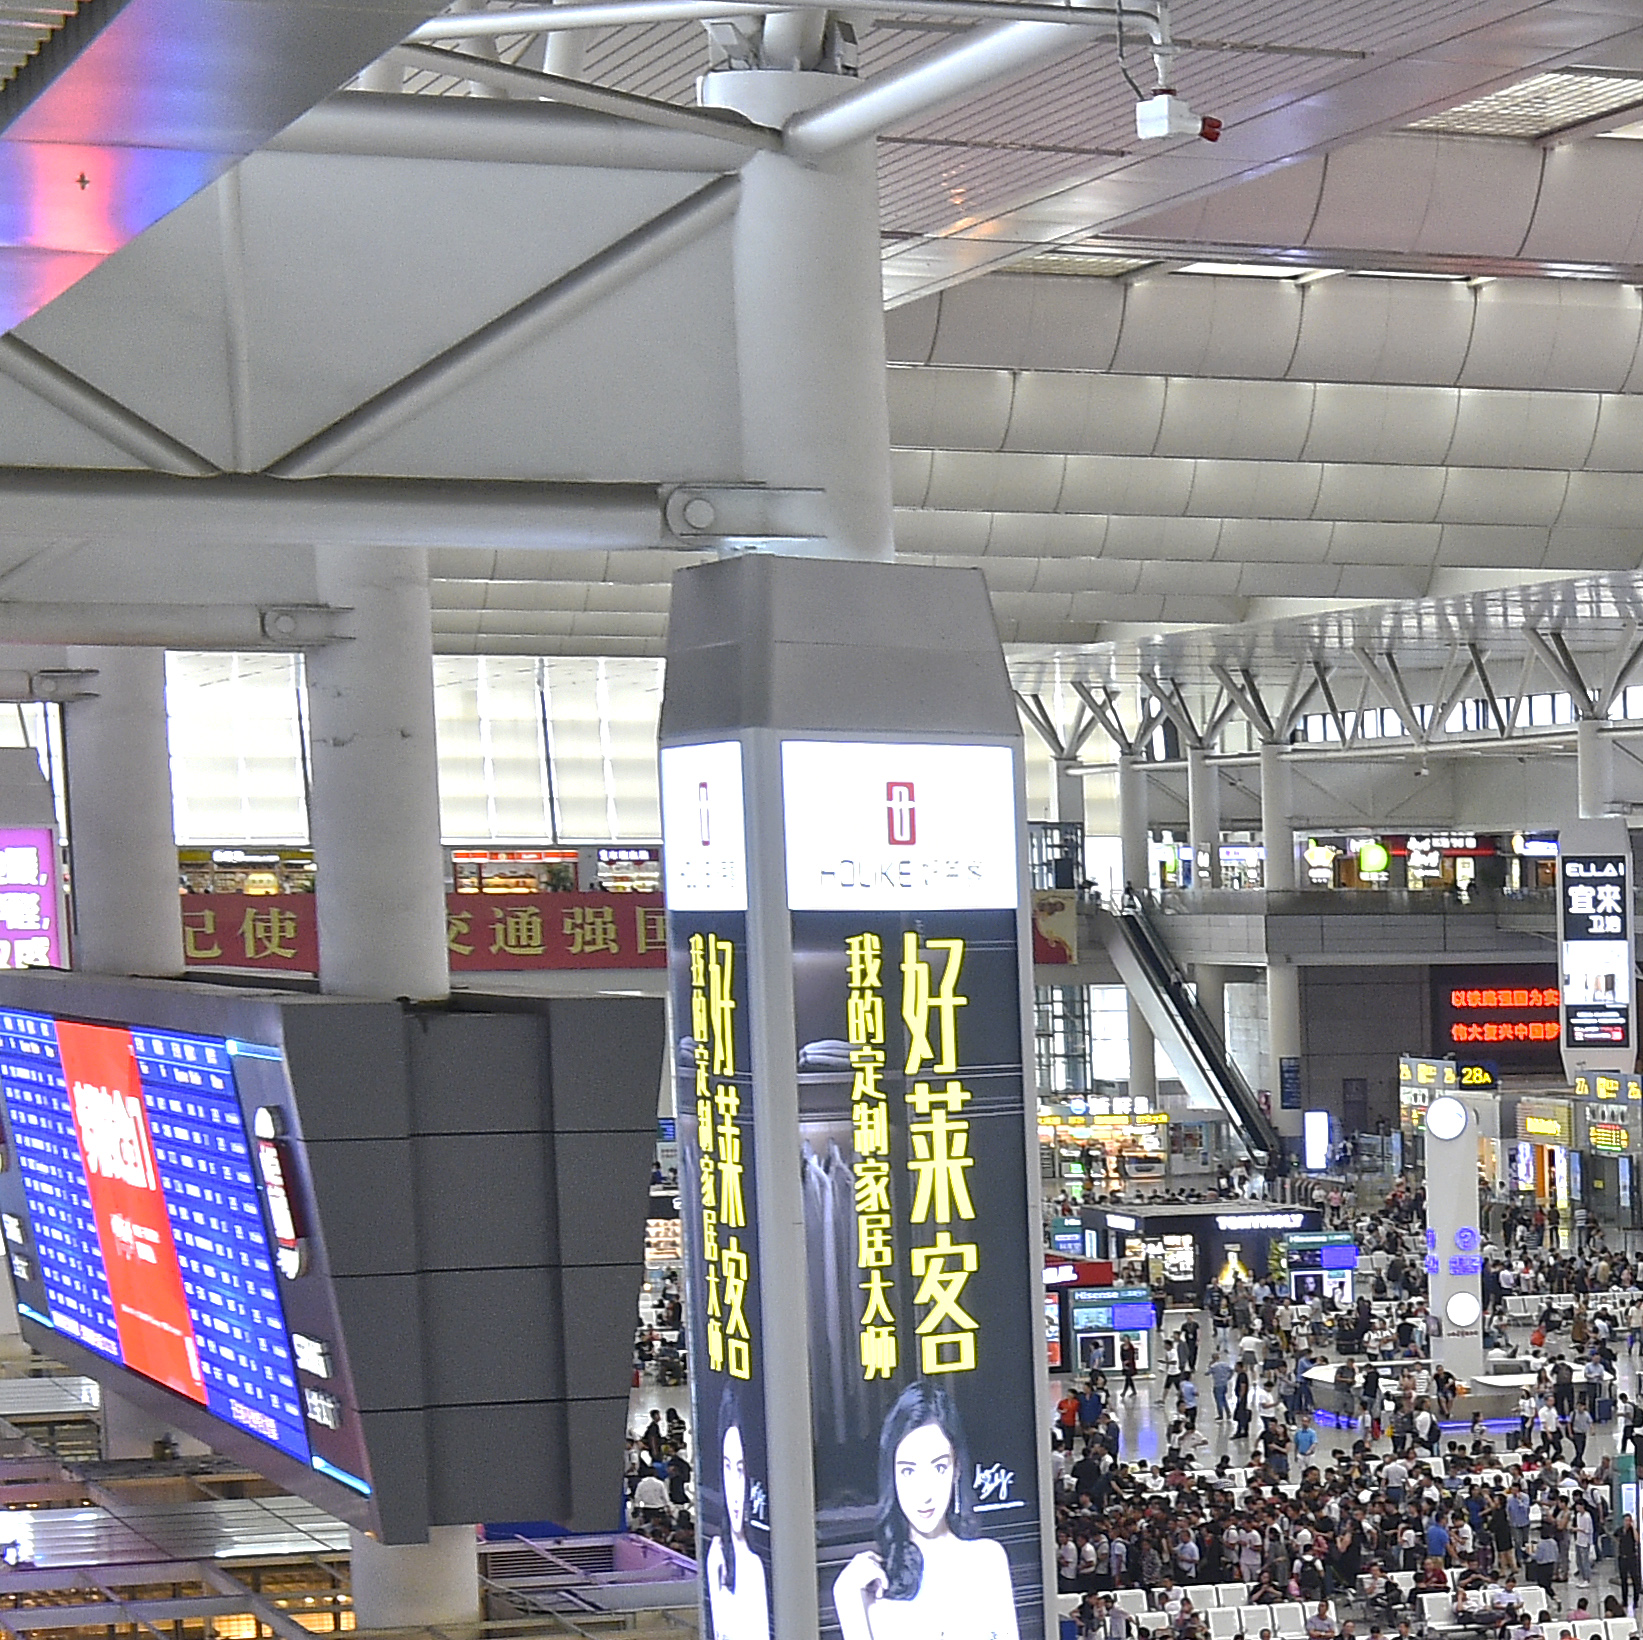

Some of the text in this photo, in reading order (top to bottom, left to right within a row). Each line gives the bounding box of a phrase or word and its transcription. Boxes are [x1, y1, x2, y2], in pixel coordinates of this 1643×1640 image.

[1569, 884, 1621, 914] 宜来
[1462, 1067, 1491, 1085] 28A
[845, 933, 898, 1380] 我的定制家居大师
[901, 932, 979, 1375] 好莱客
[1075, 1290, 1118, 1300] Hisense
